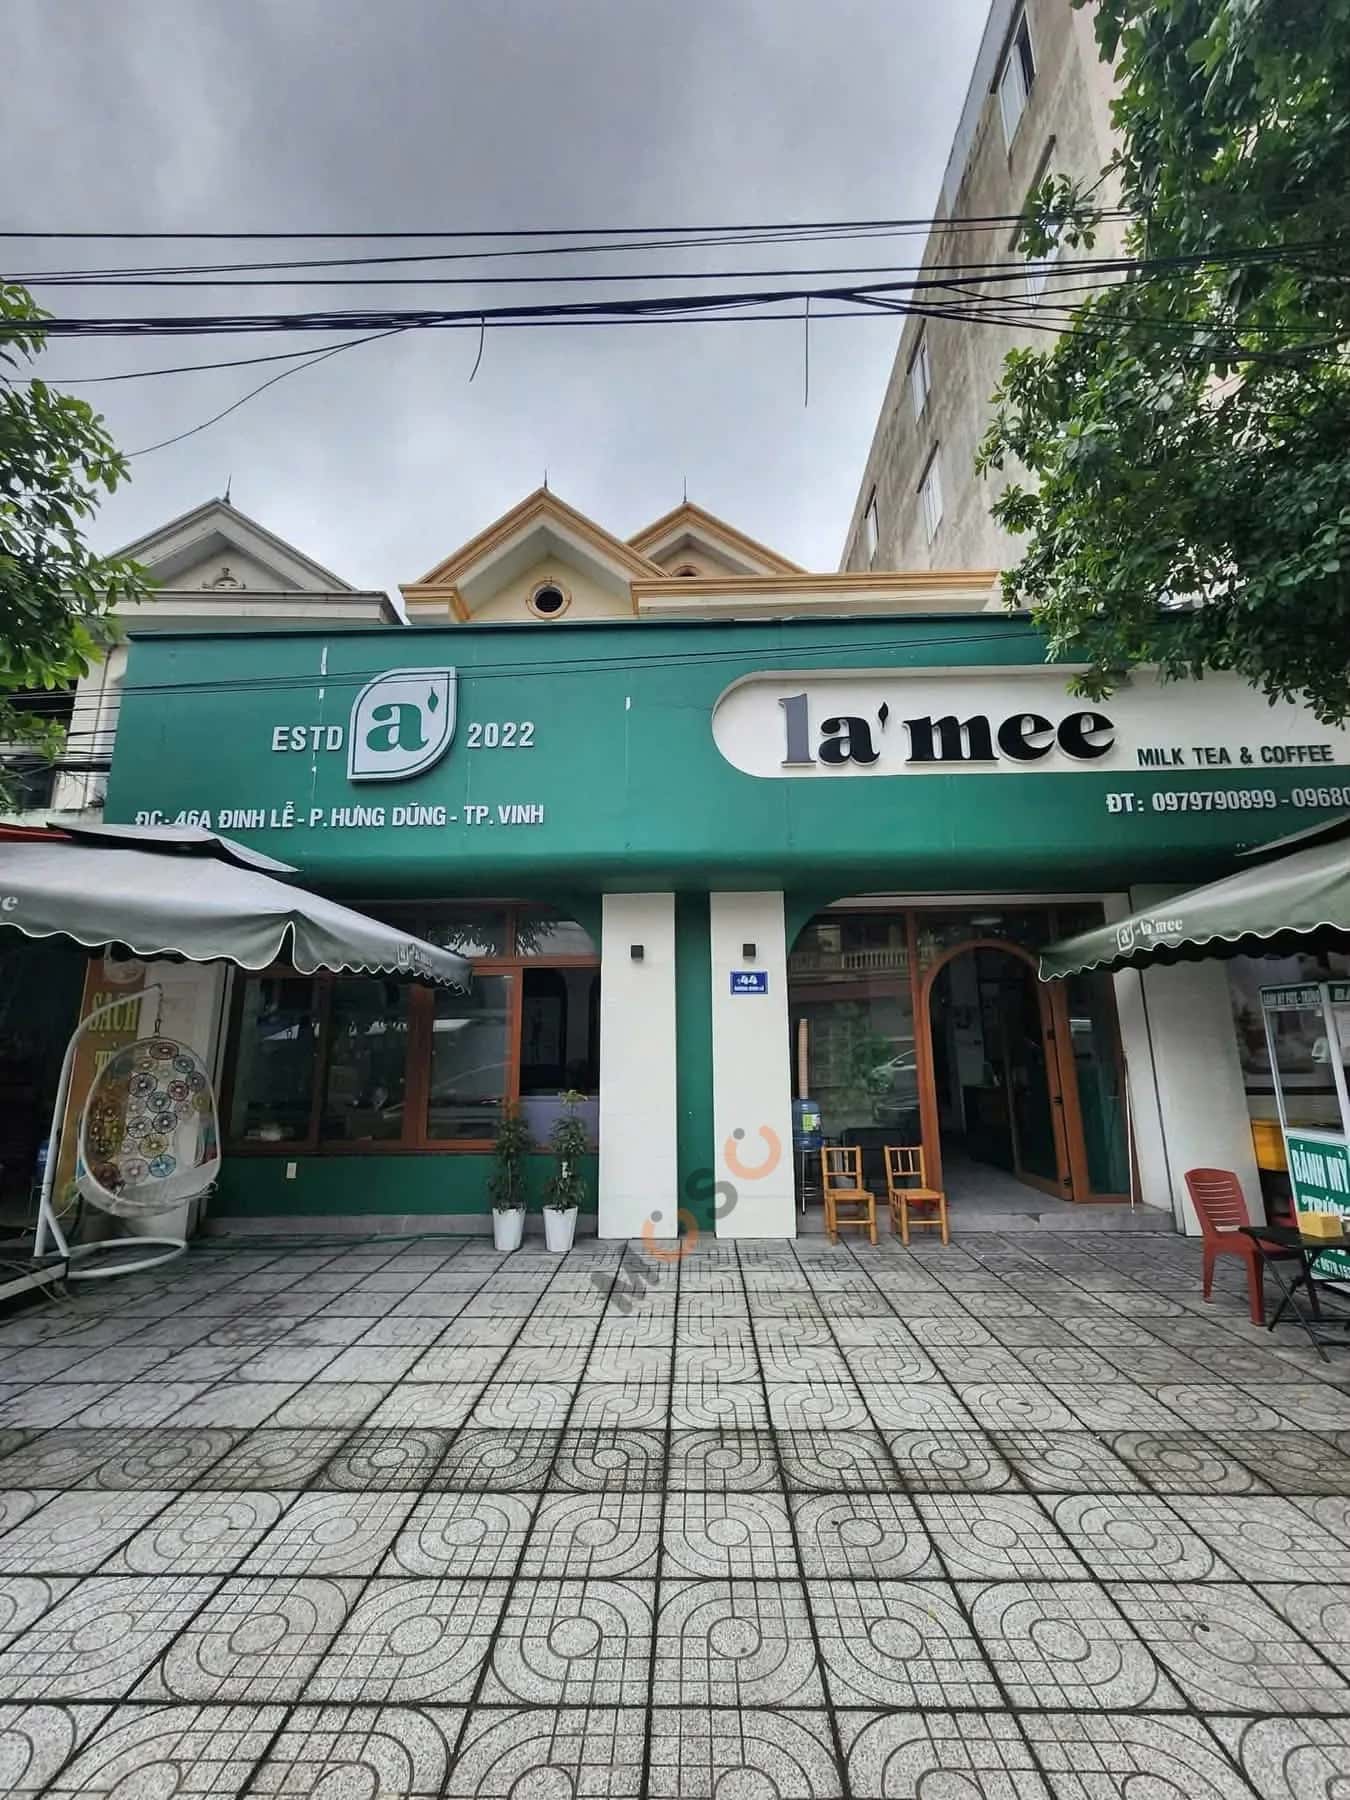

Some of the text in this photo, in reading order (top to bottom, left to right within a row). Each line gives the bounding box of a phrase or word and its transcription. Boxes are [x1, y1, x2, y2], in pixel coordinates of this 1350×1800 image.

[271, 726, 344, 752] ESTD
[466, 721, 536, 748] 2022
[1136, 744, 1335, 767] MILK TEA & COFFEE
[1152, 789, 1277, 812] 0979790899
[217, 808, 266, 829] ĐINH
[269, 801, 295, 828] LỄ
[392, 802, 447, 826] DŨNG
[498, 804, 544, 825] VINH
[740, 974, 758, 985] 44
